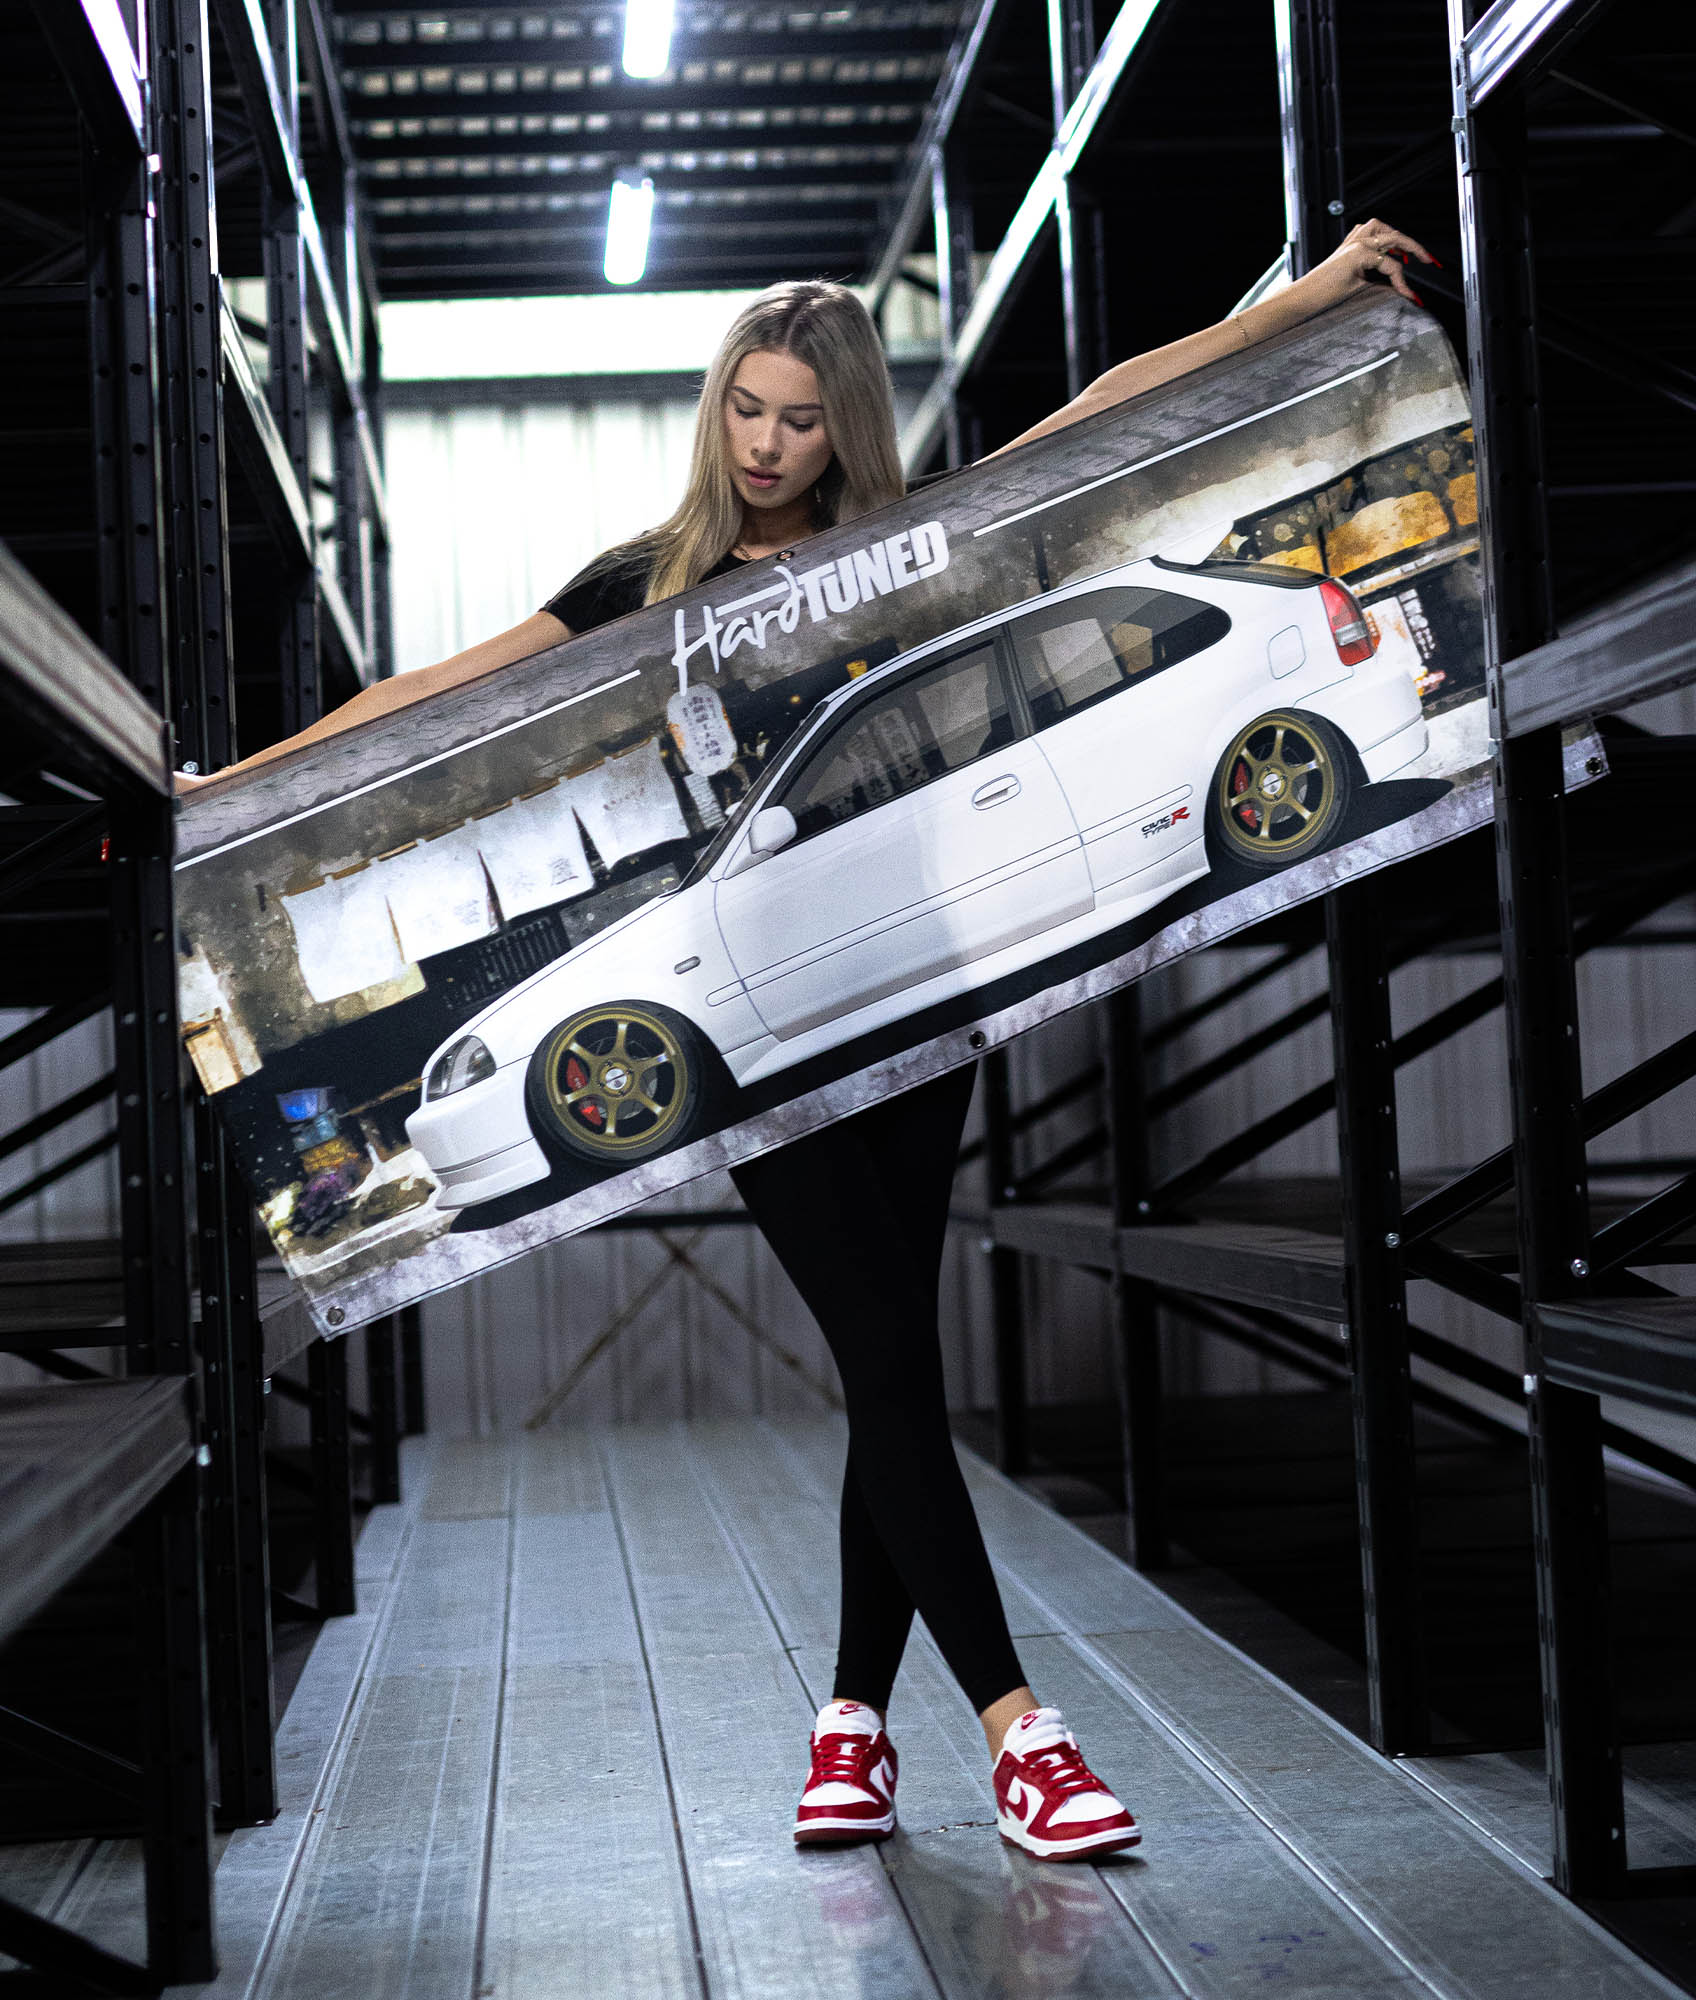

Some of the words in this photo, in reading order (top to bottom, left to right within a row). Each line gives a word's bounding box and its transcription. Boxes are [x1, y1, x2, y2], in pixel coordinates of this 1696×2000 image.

[1141, 814, 1171, 833] CIVIC
[1142, 821, 1171, 839] TYPE
[1170, 806, 1191, 826] R
